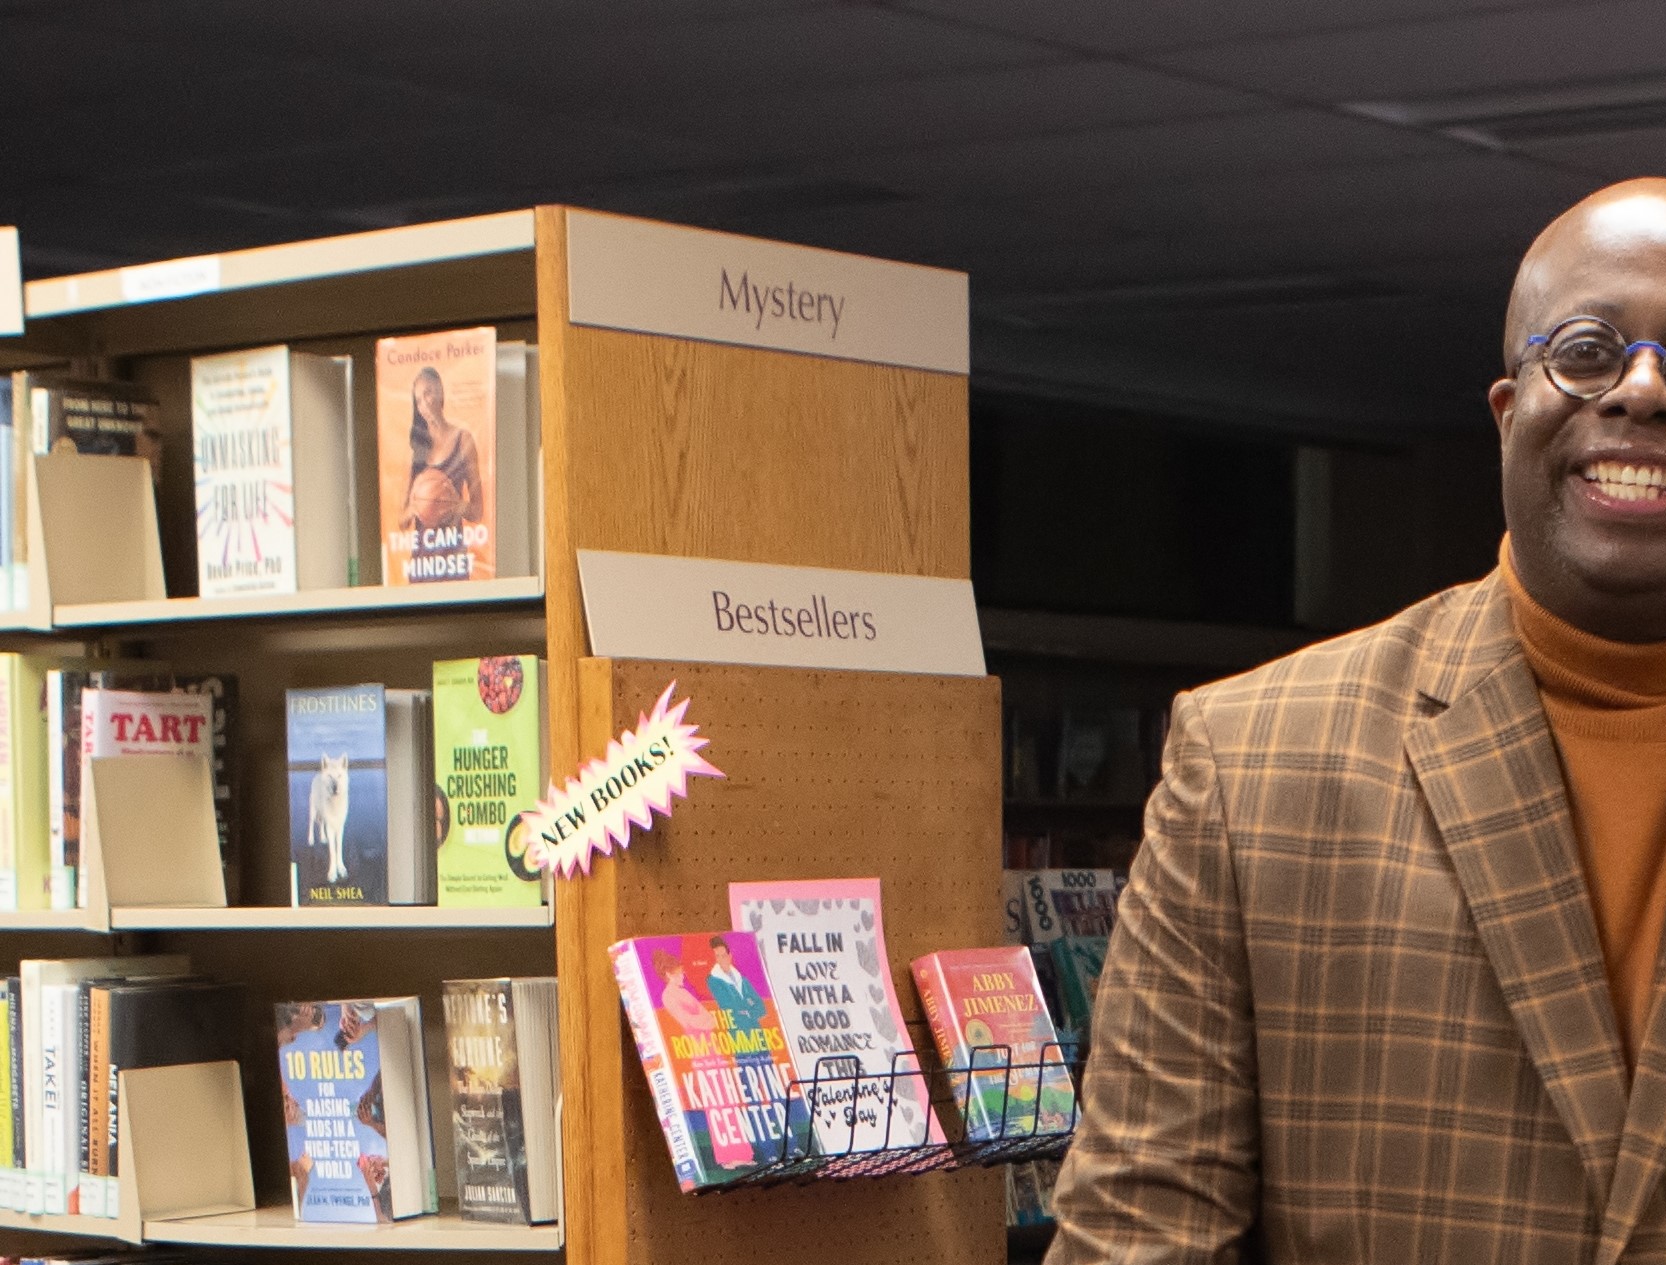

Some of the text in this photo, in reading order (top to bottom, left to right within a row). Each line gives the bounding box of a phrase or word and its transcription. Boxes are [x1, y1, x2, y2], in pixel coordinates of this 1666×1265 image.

[718, 267, 845, 340] Mystery
[386, 341, 487, 366] Candace Parker
[201, 426, 281, 473] UNMASKING
[389, 523, 489, 552] THE CAN-DO
[402, 553, 476, 579] MINDSET
[711, 590, 878, 641] Bestsellers
[110, 713, 206, 744] TART
[453, 746, 509, 772] HUNGER
[446, 772, 517, 799] CRUSHING
[541, 801, 587, 850] NEW
[589, 734, 675, 813] BOOKS!
[456, 801, 507, 826] COMBO
[309, 886, 364, 900] NEIL SHEA
[1062, 873, 1097, 888] 1000
[776, 932, 844, 953] FALL IN
[794, 961, 840, 981] LOVE
[972, 972, 1017, 993] ABBY
[789, 984, 855, 1006] WITH A
[962, 993, 1040, 1019] JIMENEZ
[711, 1009, 734, 1031] THE
[801, 1009, 850, 1031] GOOD
[671, 1026, 785, 1061] ROM-COMMERS
[798, 1031, 877, 1055] ROMANCE
[285, 1051, 366, 1080] 10 RULES
[44, 1046, 57, 1111] TAKEI
[317, 1082, 336, 1098] FOR
[681, 1062, 793, 1109] KATHERINE
[306, 1098, 351, 1118] RAISING
[306, 1120, 332, 1138] KIDS
[708, 1103, 794, 1147] CENTER
[304, 1139, 361, 1159] HIGH-TECH
[314, 1162, 353, 1181] WORLD
